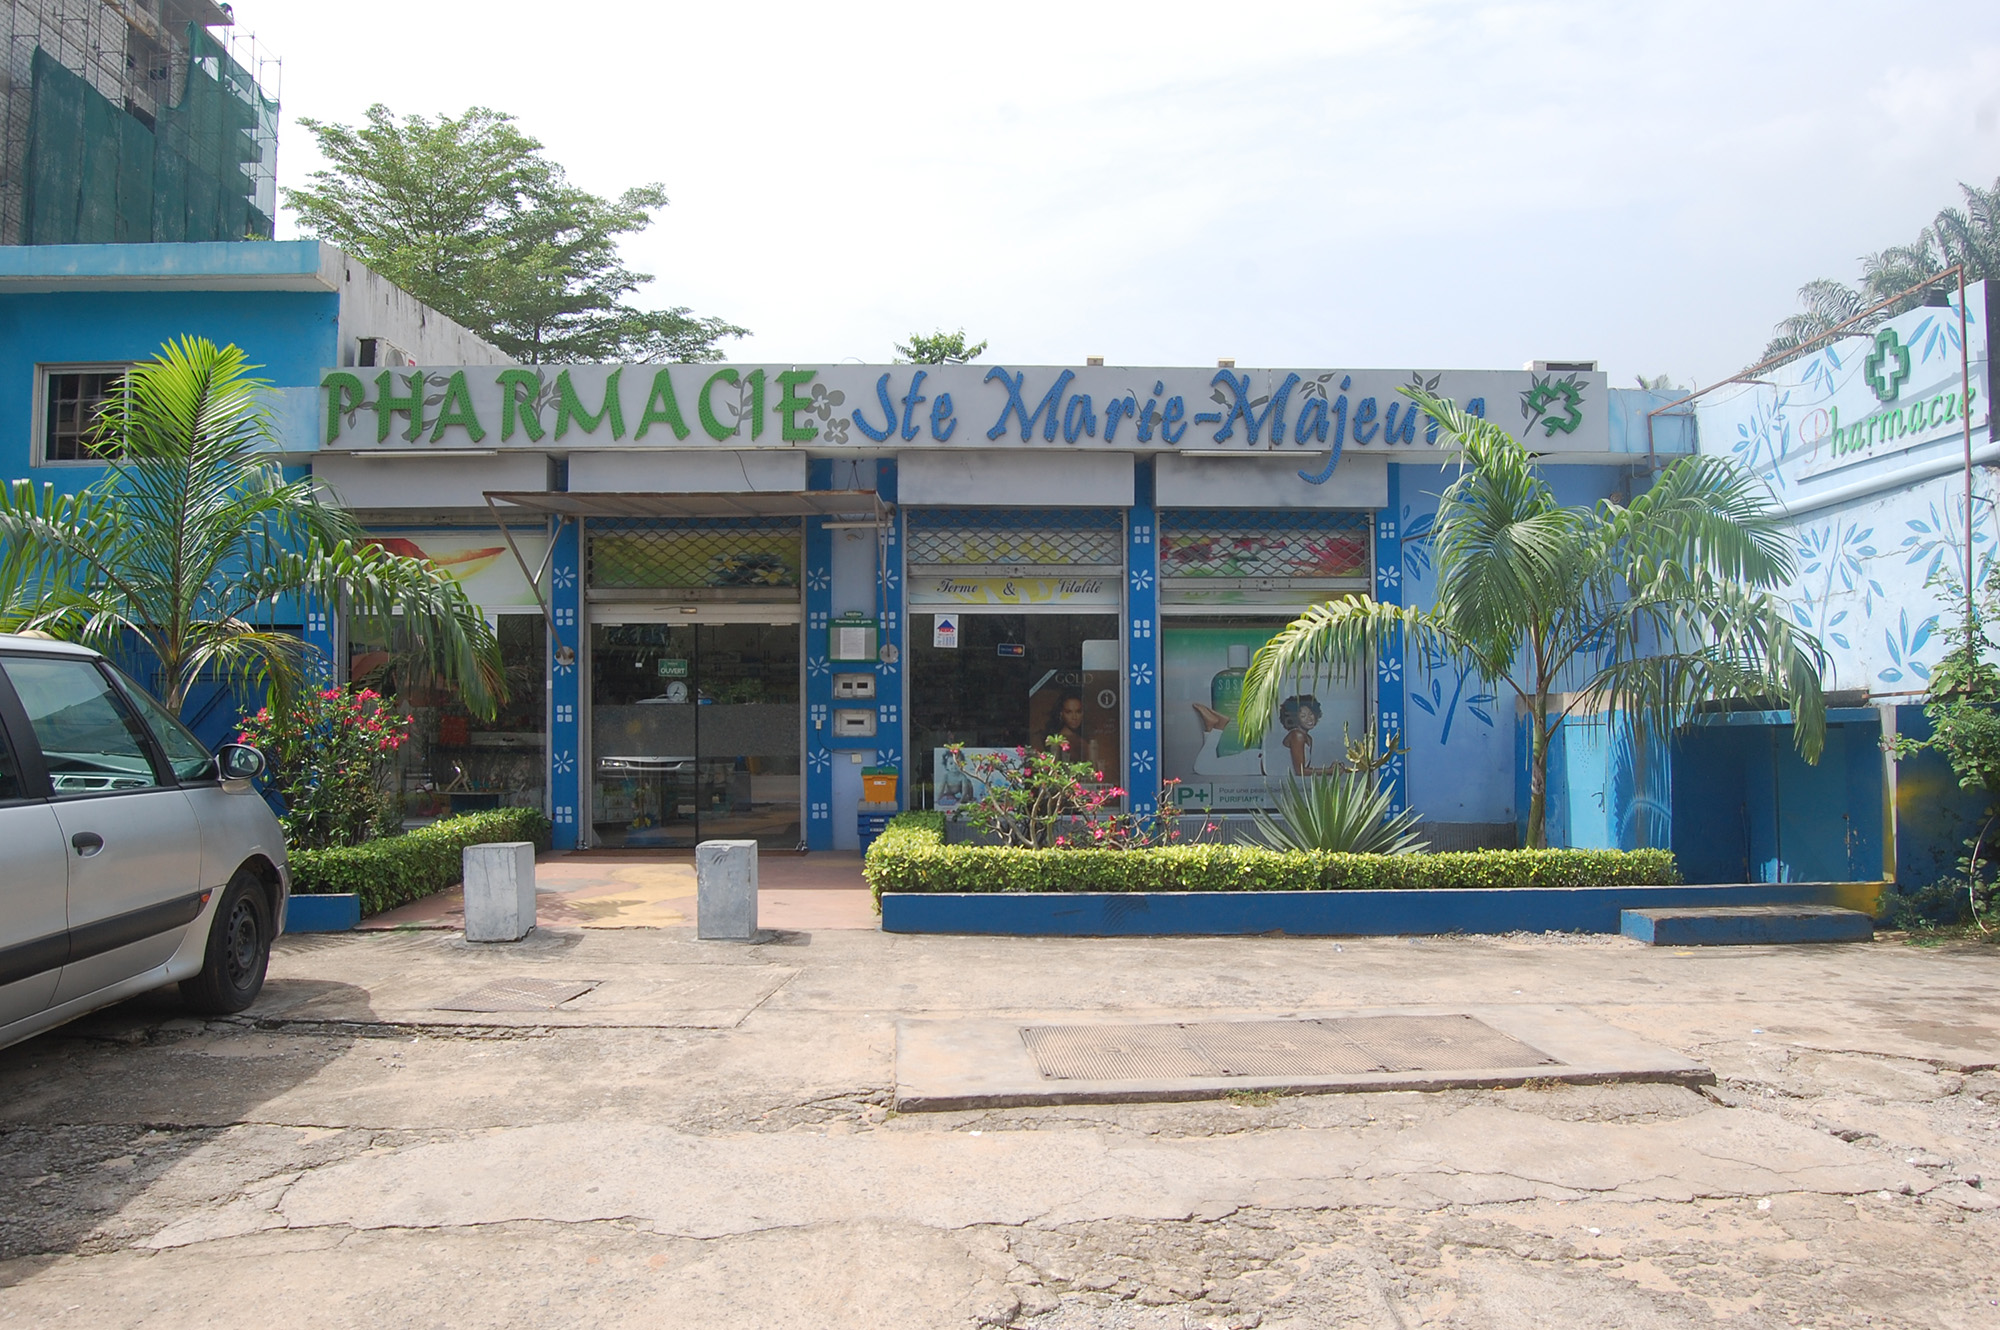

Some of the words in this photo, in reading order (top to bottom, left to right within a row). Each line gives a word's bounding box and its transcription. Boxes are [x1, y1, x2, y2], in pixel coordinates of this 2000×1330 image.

[321, 366, 819, 445] PHARMACIE
[851, 369, 957, 442] Ste
[1799, 387, 1977, 464] Pharmacie
[1003, 582, 1016, 596] &
[1055, 673, 1094, 685] GOLD
